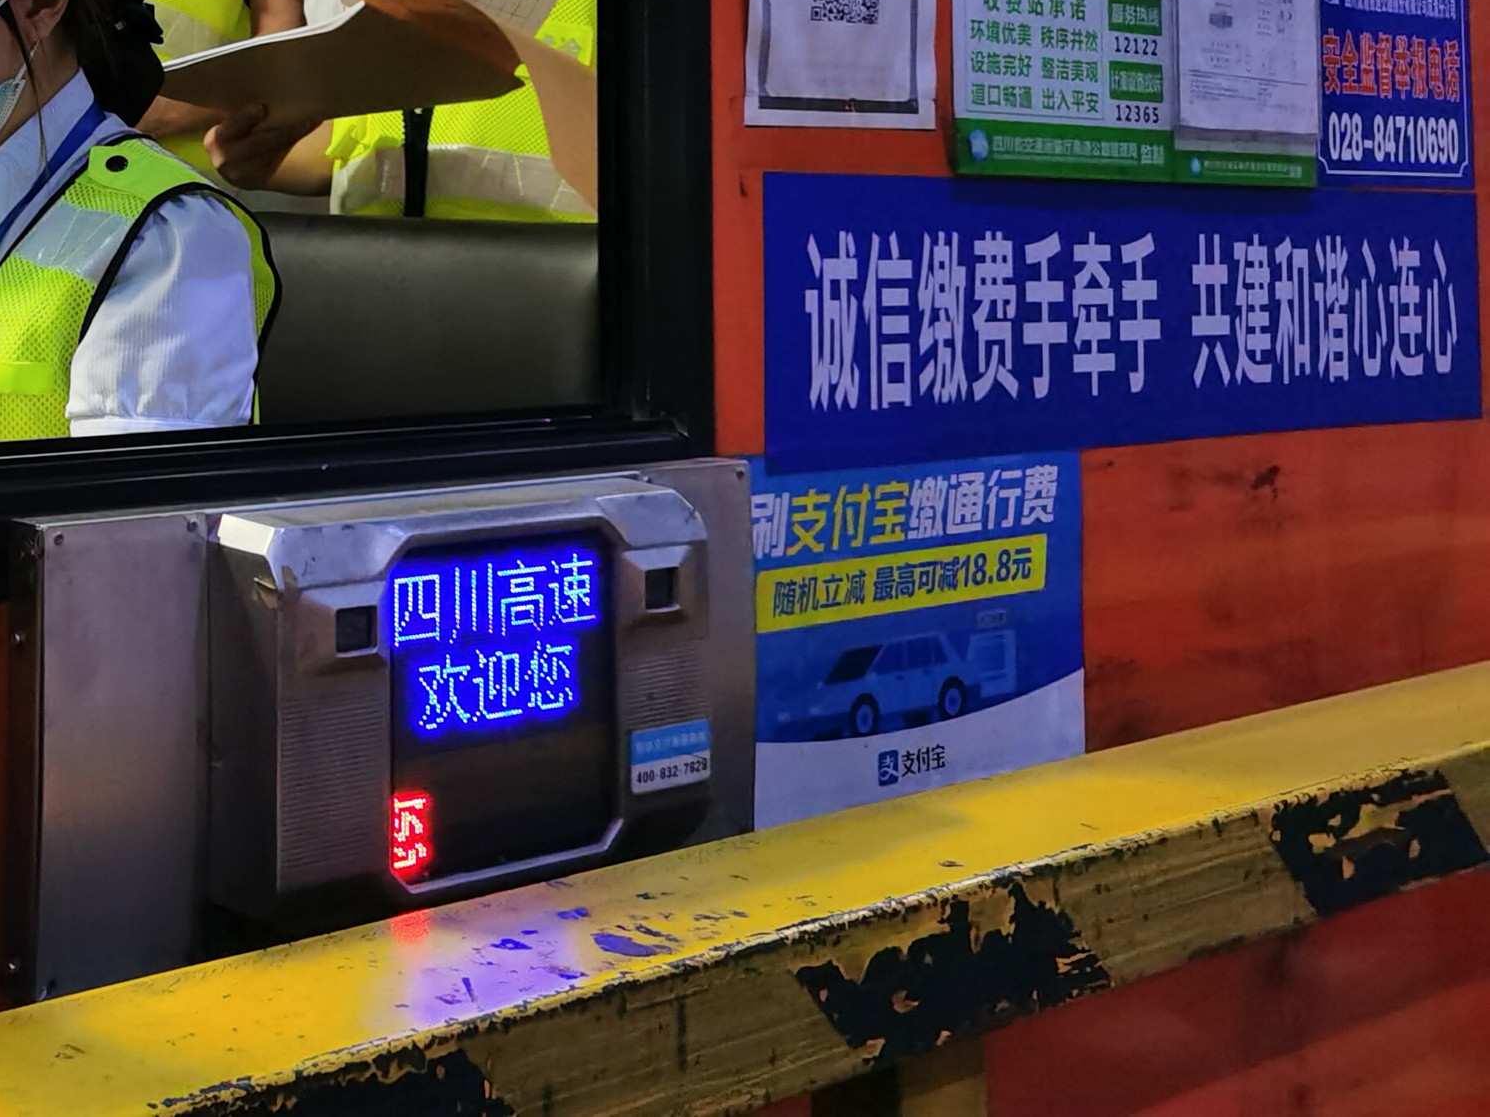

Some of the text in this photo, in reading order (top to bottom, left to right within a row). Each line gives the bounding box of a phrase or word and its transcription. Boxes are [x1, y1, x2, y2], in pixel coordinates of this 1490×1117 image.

[970, 19, 1098, 52] 环境优美 秩序井然
[1114, 36, 1159, 57] 12122
[970, 51, 1098, 83] 设施完好 整洁美观
[1323, 28, 1460, 102] 安全监督举报电话
[971, 83, 1099, 113] 道口畅通 出入平安
[1115, 104, 1160, 124] 12365
[1328, 111, 1459, 165] 028-84710690
[804, 229, 1458, 413] 诚信缴费手牵手 共建和谐心连心
[751, 464, 1059, 559] 刷支付宝缴通行费
[393, 553, 597, 648] 四川高速
[772, 547, 1033, 619] 随机立减 最高可减18.8元
[419, 641, 574, 731] 欢迎您
[901, 743, 947, 777] 支付宝
